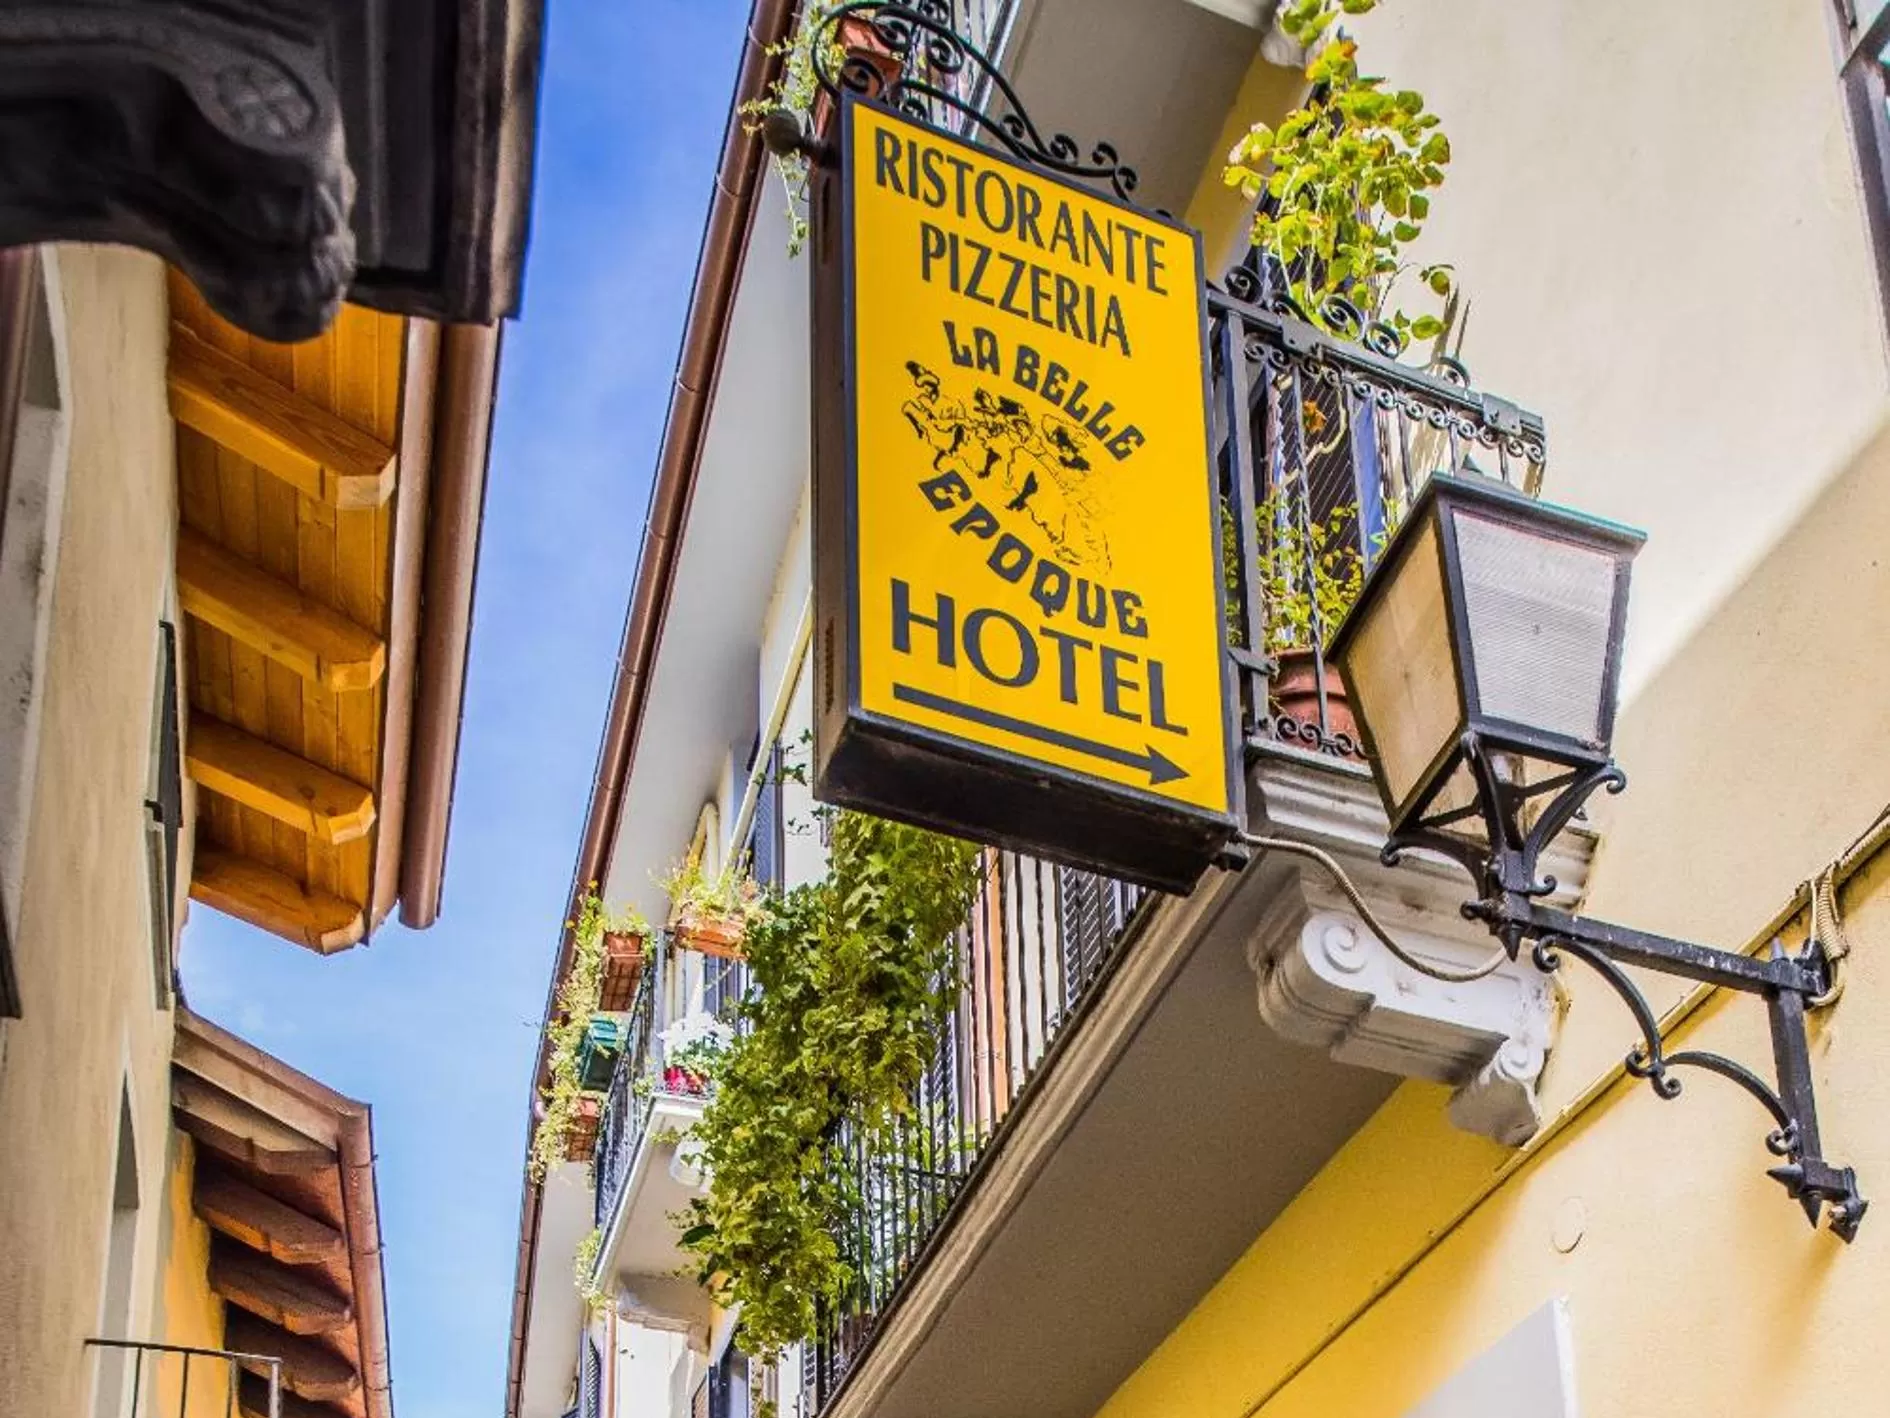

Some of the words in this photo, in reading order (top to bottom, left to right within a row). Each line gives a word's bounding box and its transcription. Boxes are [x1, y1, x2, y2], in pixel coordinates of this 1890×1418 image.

[875, 127, 1169, 296] RISTORANTE
[921, 222, 1131, 357] PIZZERIA
[943, 320, 1000, 376] LA
[1014, 346, 1145, 461] BELLE
[919, 469, 1148, 639] EPOQUE
[891, 577, 1188, 736] HOTEL
